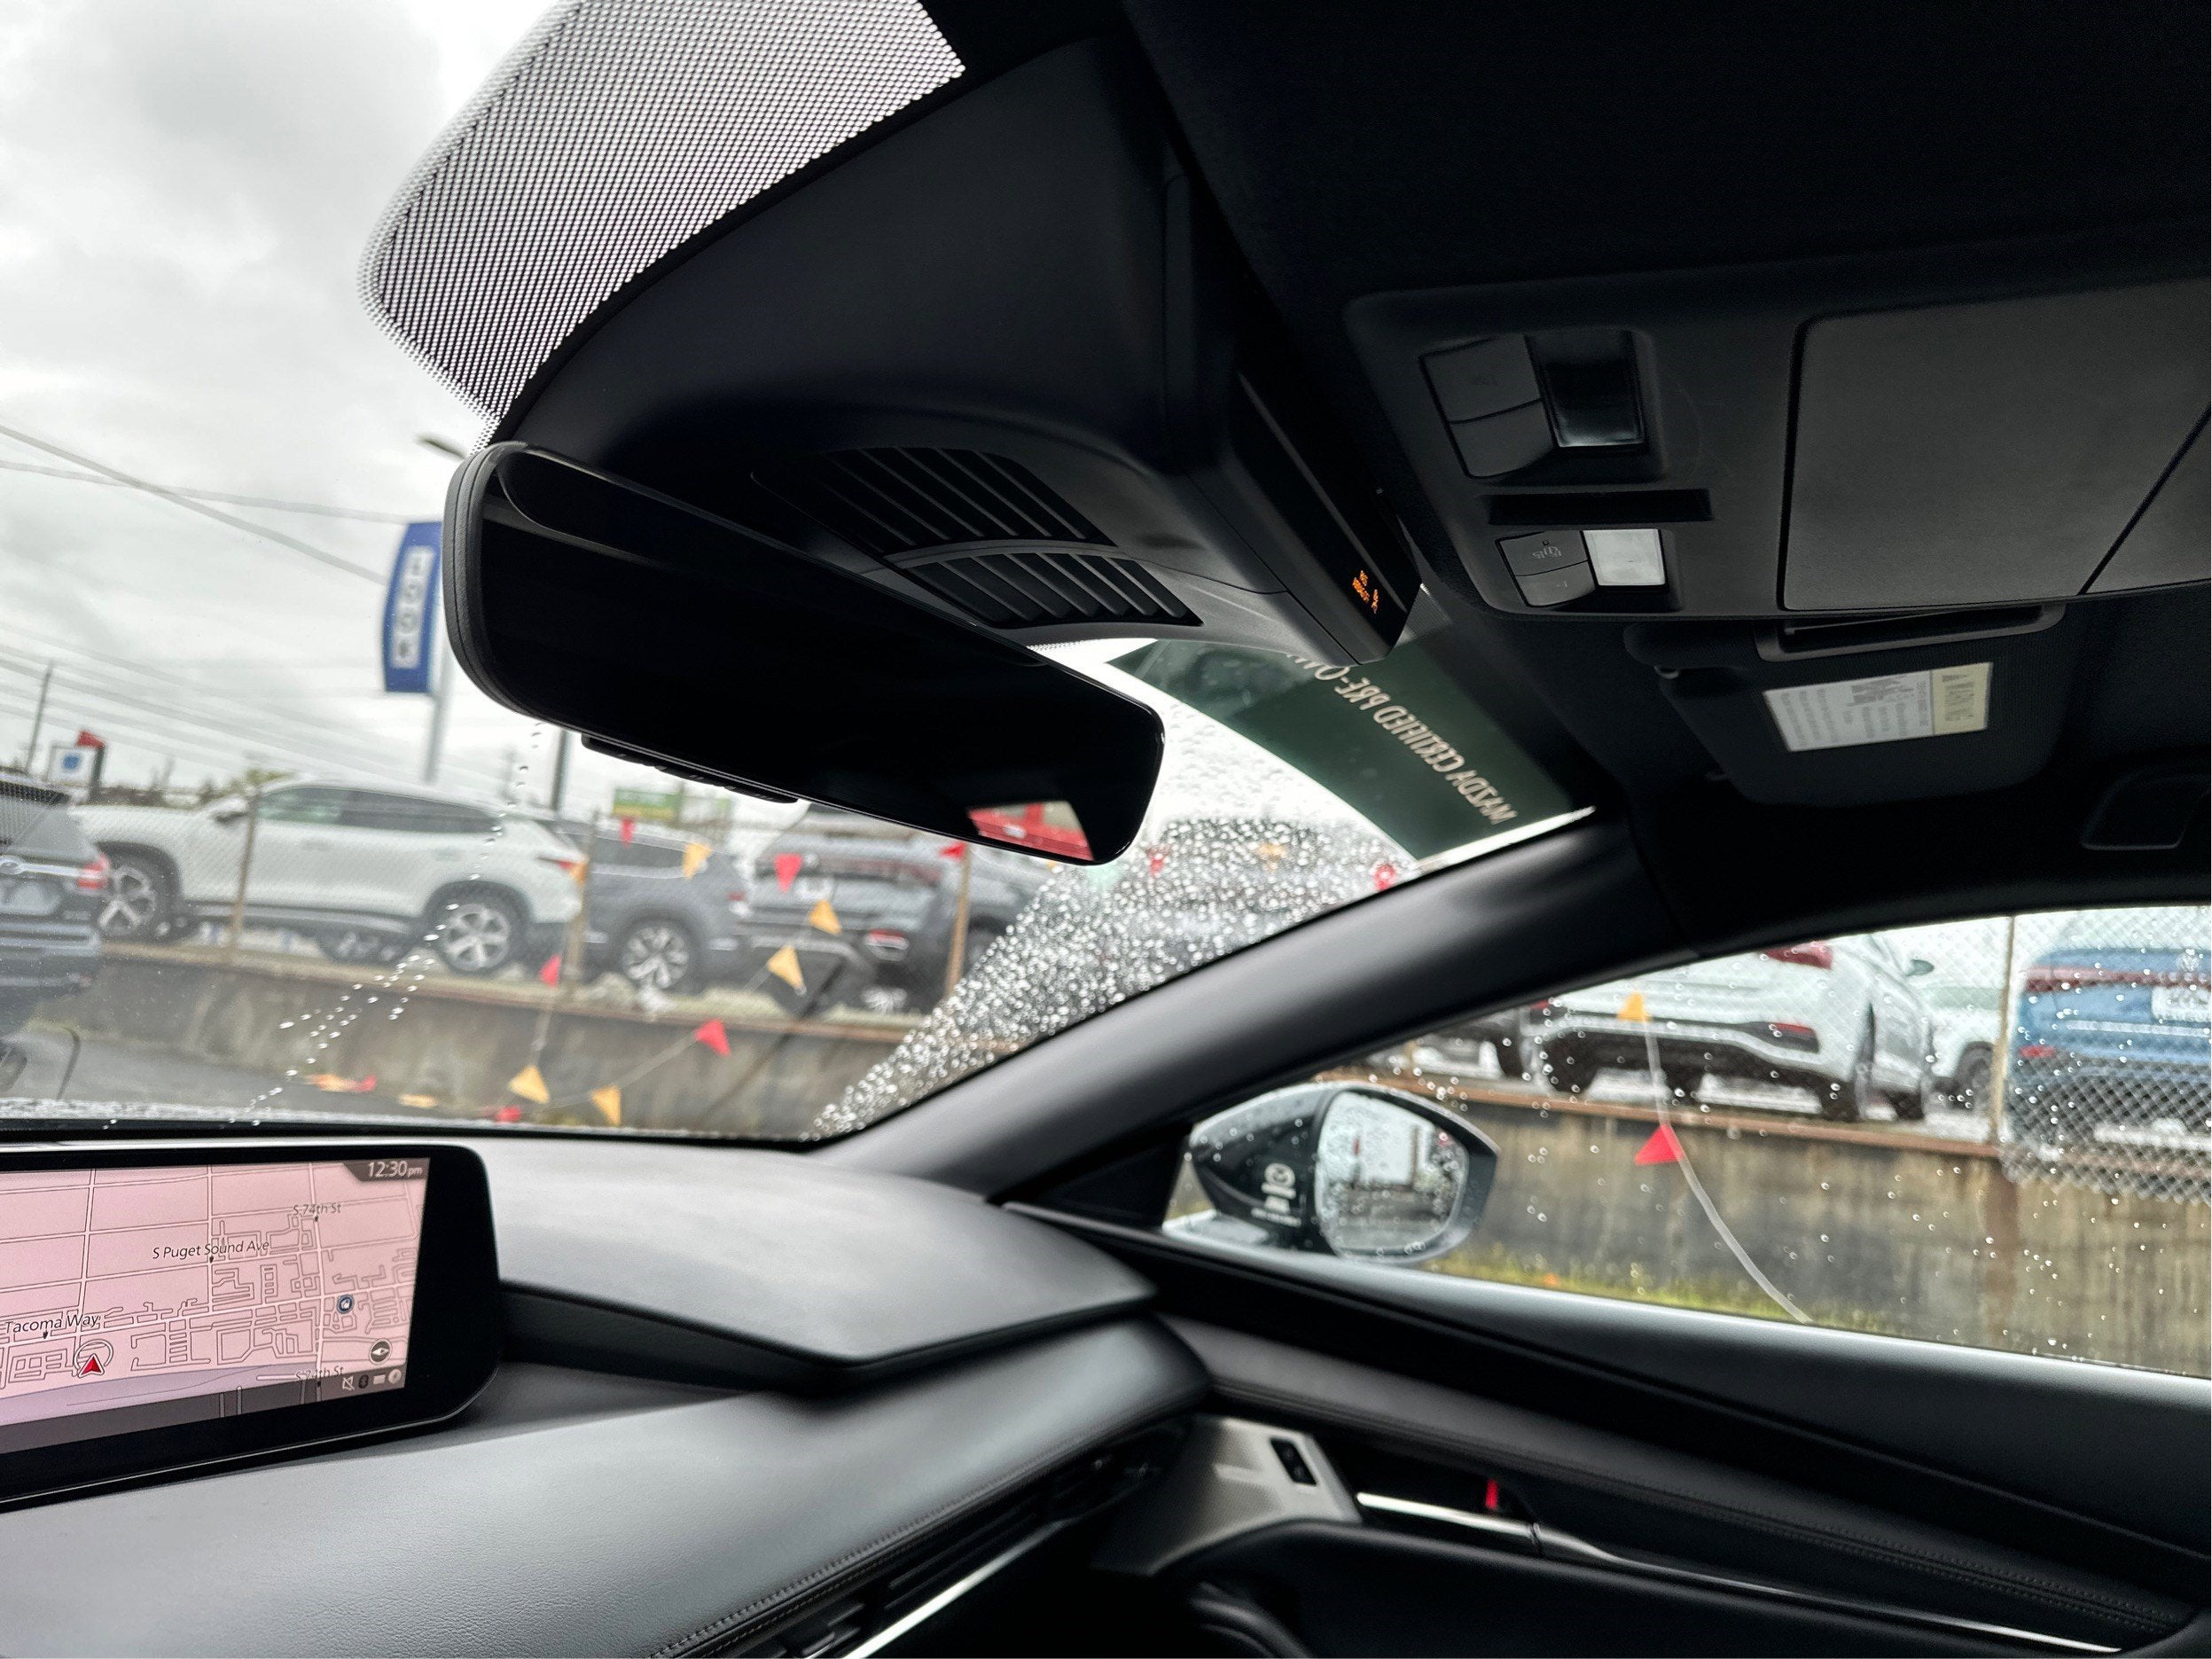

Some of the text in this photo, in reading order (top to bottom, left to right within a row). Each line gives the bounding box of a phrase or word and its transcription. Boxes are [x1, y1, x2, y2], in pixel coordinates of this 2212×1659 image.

[293, 1204, 300, 1216] S
[331, 1201, 341, 1214] St
[152, 1240, 270, 1260] S Puget Sound Ave
[5, 1313, 99, 1334] Tacoma Way
